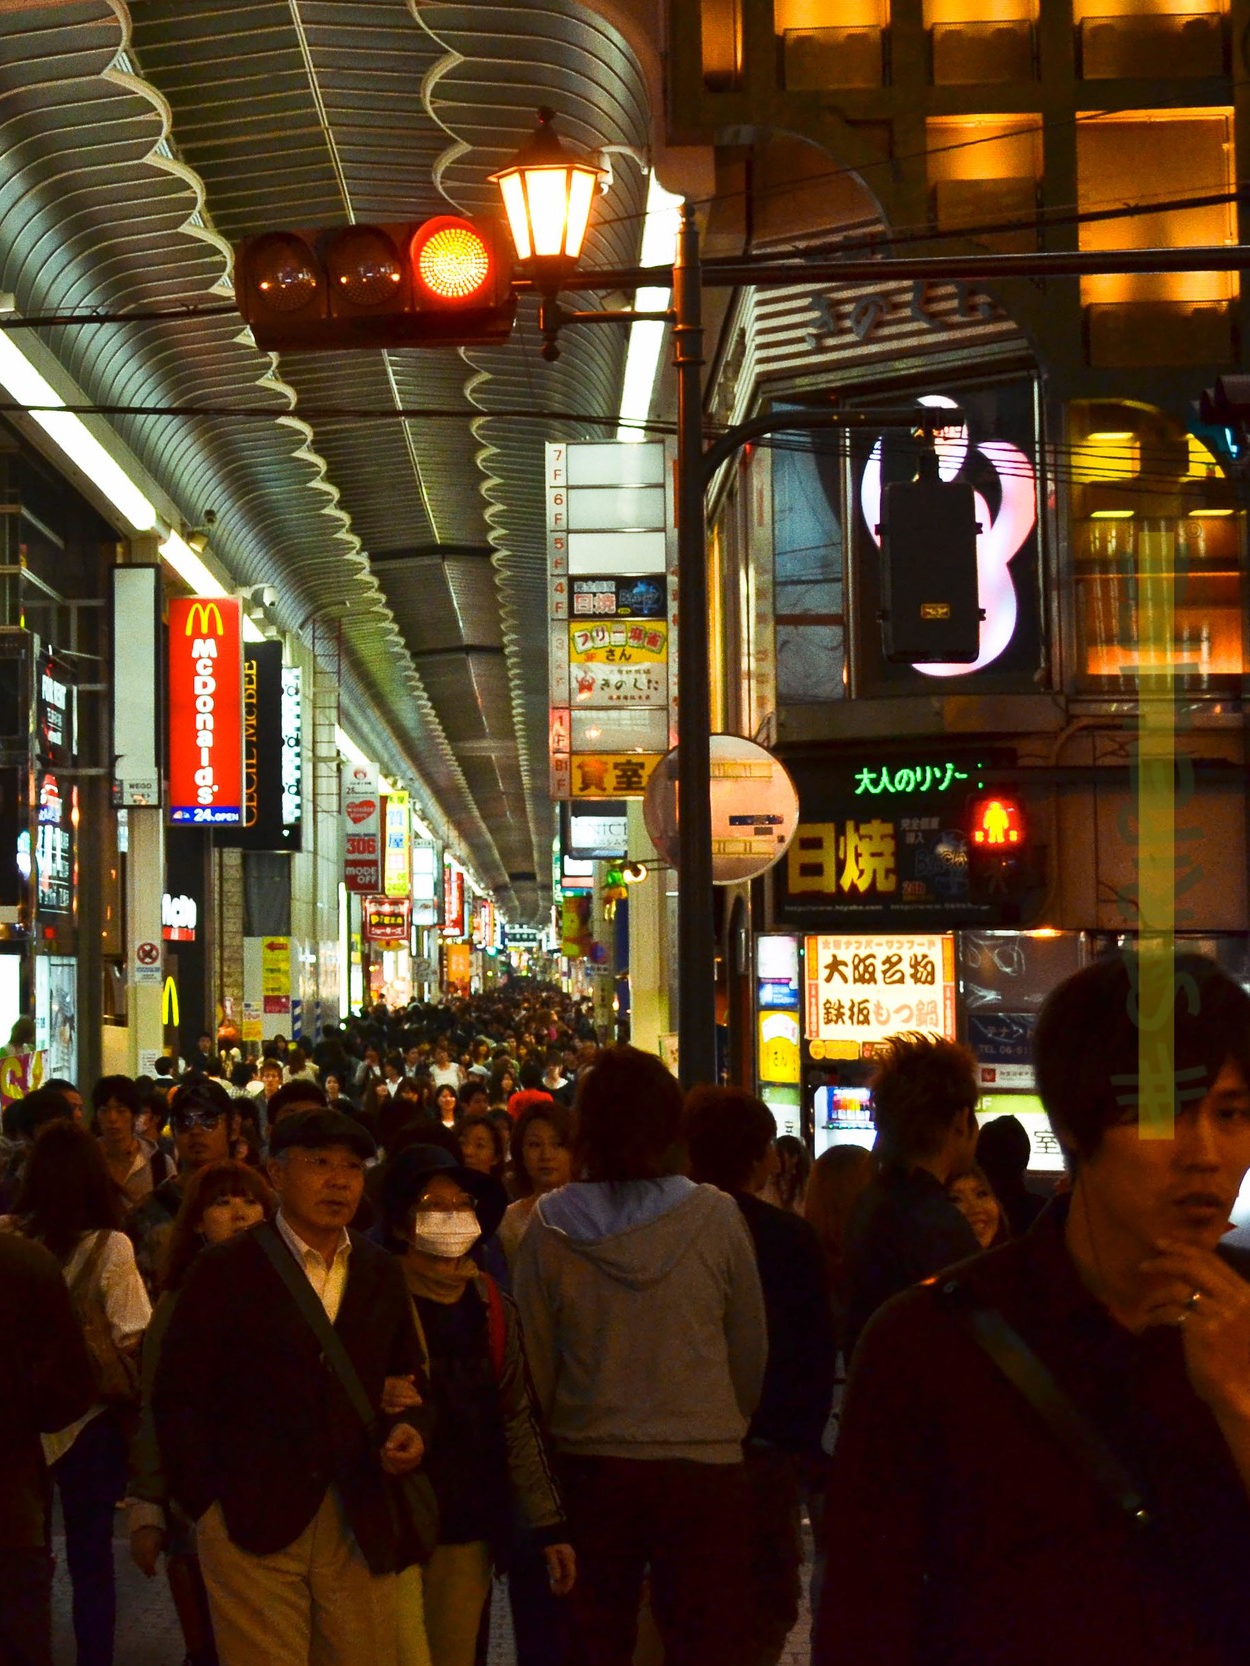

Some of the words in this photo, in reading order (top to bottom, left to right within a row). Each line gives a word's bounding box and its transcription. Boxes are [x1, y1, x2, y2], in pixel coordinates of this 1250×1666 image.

[576, 626, 662, 649] フリー麻雀
[606, 648, 632, 661] さん
[191, 638, 219, 804] McDonald's
[787, 818, 897, 894] 日焼
[823, 953, 936, 986] 大阪名物
[822, 998, 940, 1028] 鉄板もつ鍋
[1034, 1129, 1061, 1155] 室
